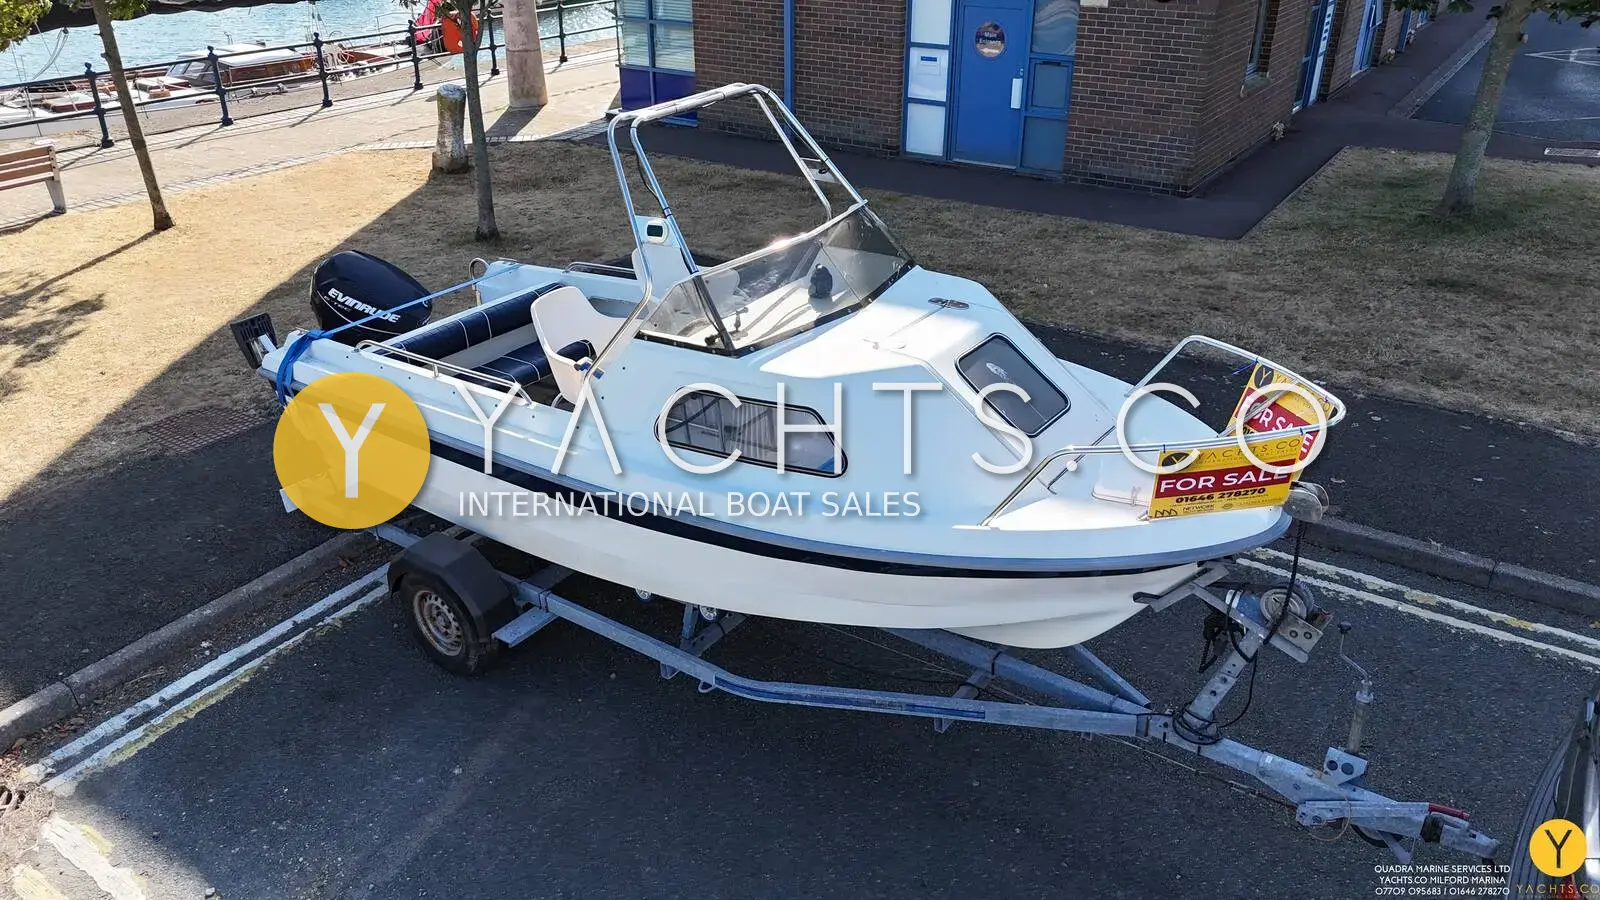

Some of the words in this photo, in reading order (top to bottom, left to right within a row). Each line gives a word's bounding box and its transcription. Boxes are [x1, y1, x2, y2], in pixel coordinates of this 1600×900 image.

[327, 287, 401, 323] EVINRUDE
[1160, 476, 1216, 493] FOR
[1222, 467, 1289, 486] SALE
[1175, 494, 1215, 504] 01646
[1218, 487, 1266, 499] 278270
